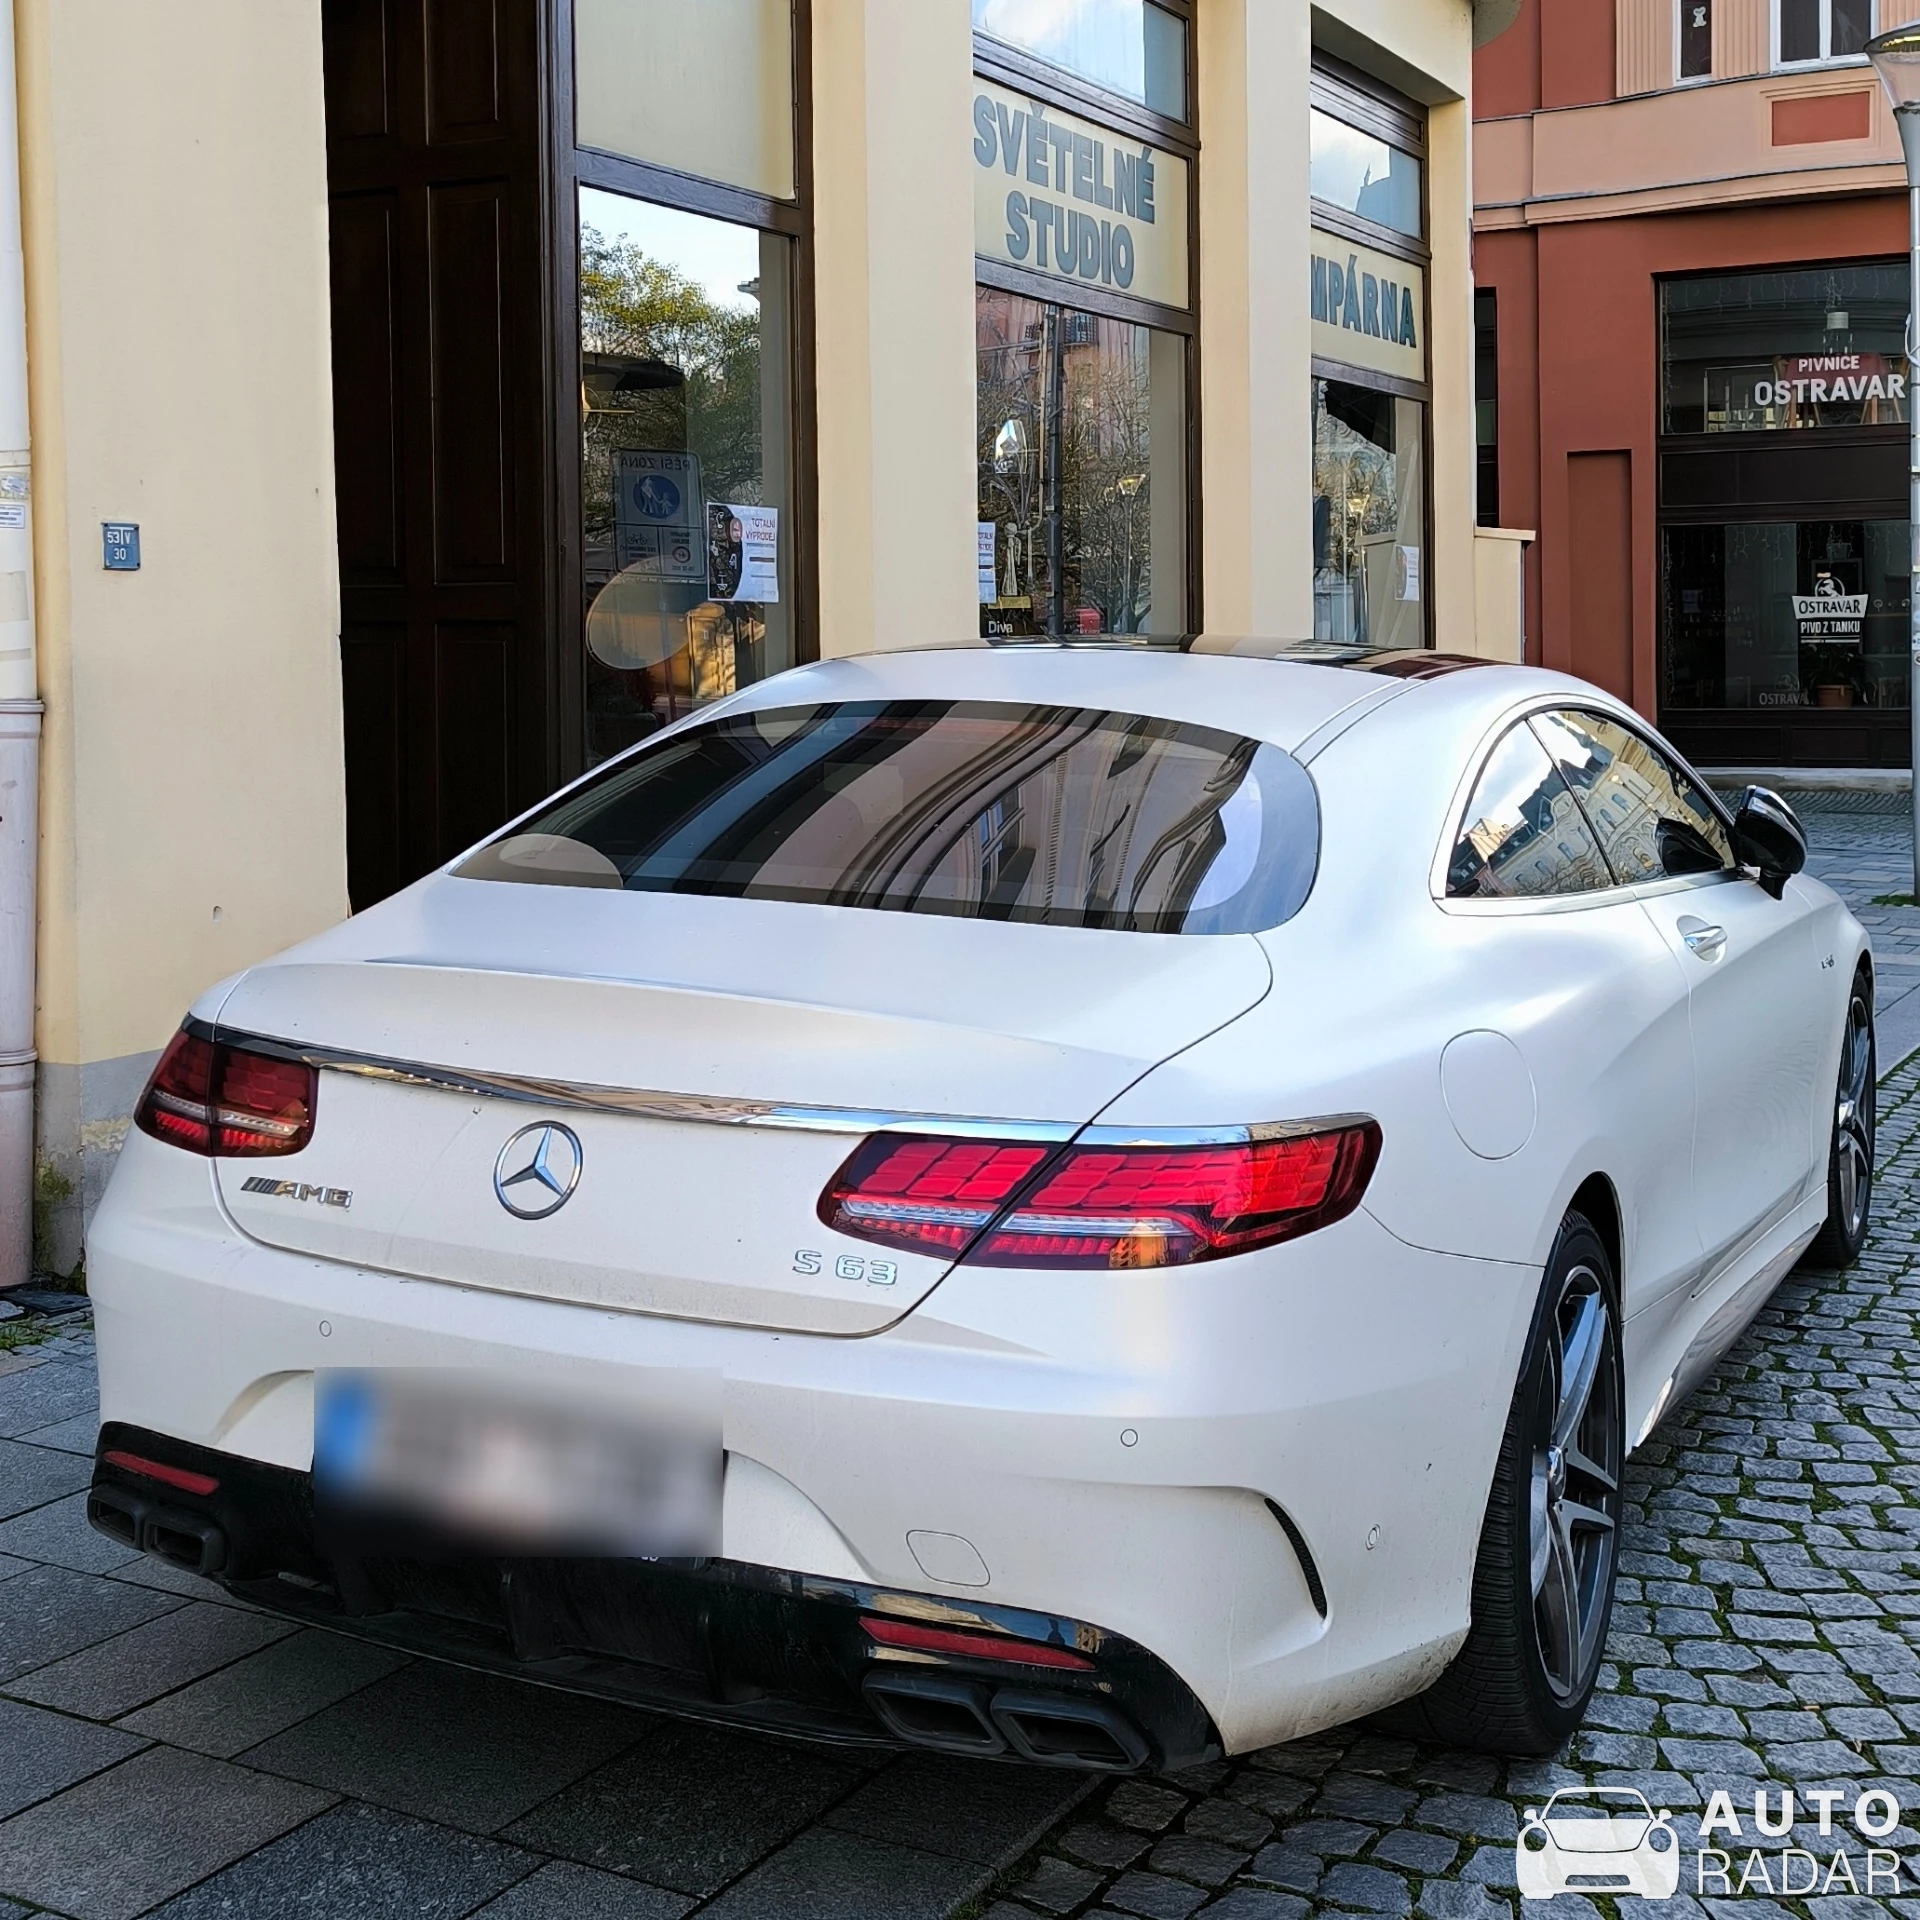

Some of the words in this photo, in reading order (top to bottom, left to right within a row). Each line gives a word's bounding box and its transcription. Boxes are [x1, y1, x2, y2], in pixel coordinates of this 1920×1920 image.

[973, 94, 1155, 225] SVĚTELNÉ
[1006, 190, 1135, 289] STUDIO
[1798, 355, 1860, 373] PIVNICE
[1754, 373, 1906, 406] OSTRAVAR
[113, 547, 127, 560] 30
[1798, 599, 1861, 615] OSTRAVAR
[988, 620, 1013, 634] Diva
[1800, 620, 1822, 634] PIVO
[1822, 620, 1829, 634] Z
[1830, 620, 1860, 634] TANKU
[273, 1179, 354, 1208] AMG
[792, 1249, 822, 1276] S
[835, 1254, 898, 1286] 63
